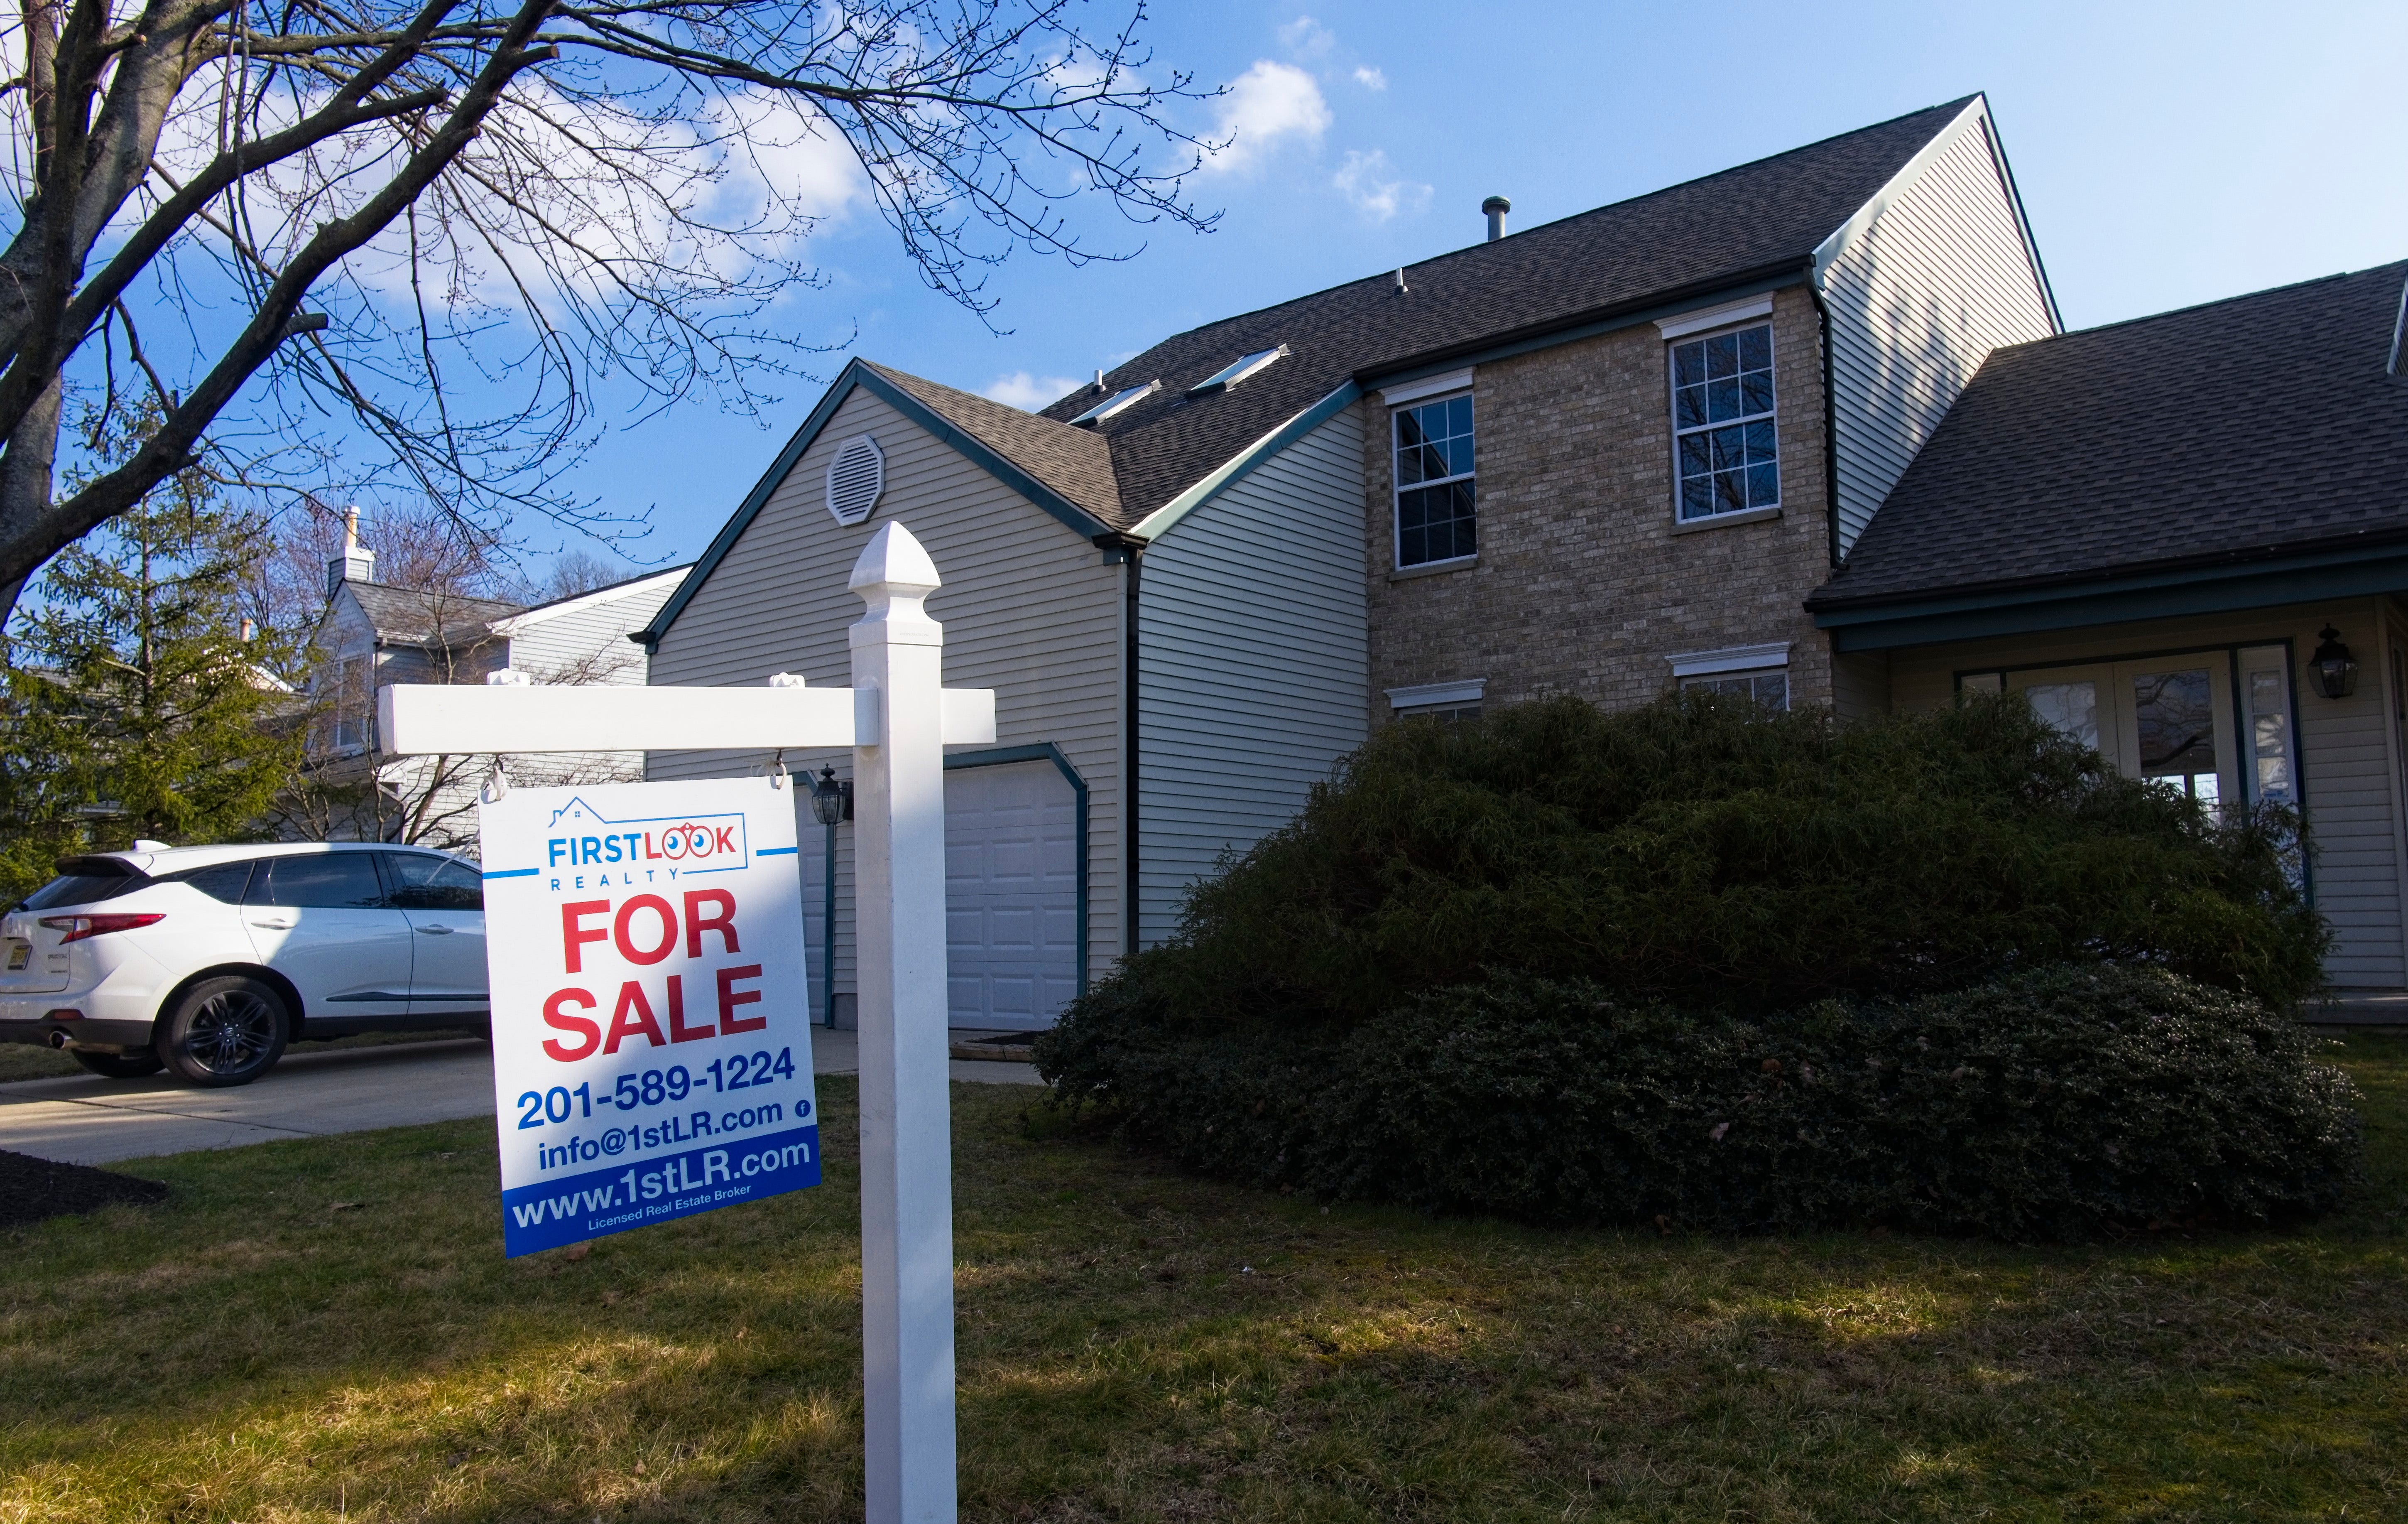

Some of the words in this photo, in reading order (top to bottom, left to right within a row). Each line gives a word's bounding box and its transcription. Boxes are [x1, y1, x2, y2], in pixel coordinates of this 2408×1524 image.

[551, 868, 678, 891] REALTY
[561, 888, 741, 974] FOR
[542, 964, 767, 1063] SALE
[517, 1047, 795, 1130] 201-589-1224
[539, 1102, 783, 1171] info@1stLR.com
[512, 1142, 810, 1229] www.1stLR.com
[588, 1209, 642, 1231] Licensed
[646, 1202, 672, 1217] Real
[676, 1194, 711, 1210] Estate
[714, 1185, 751, 1201] Broker
